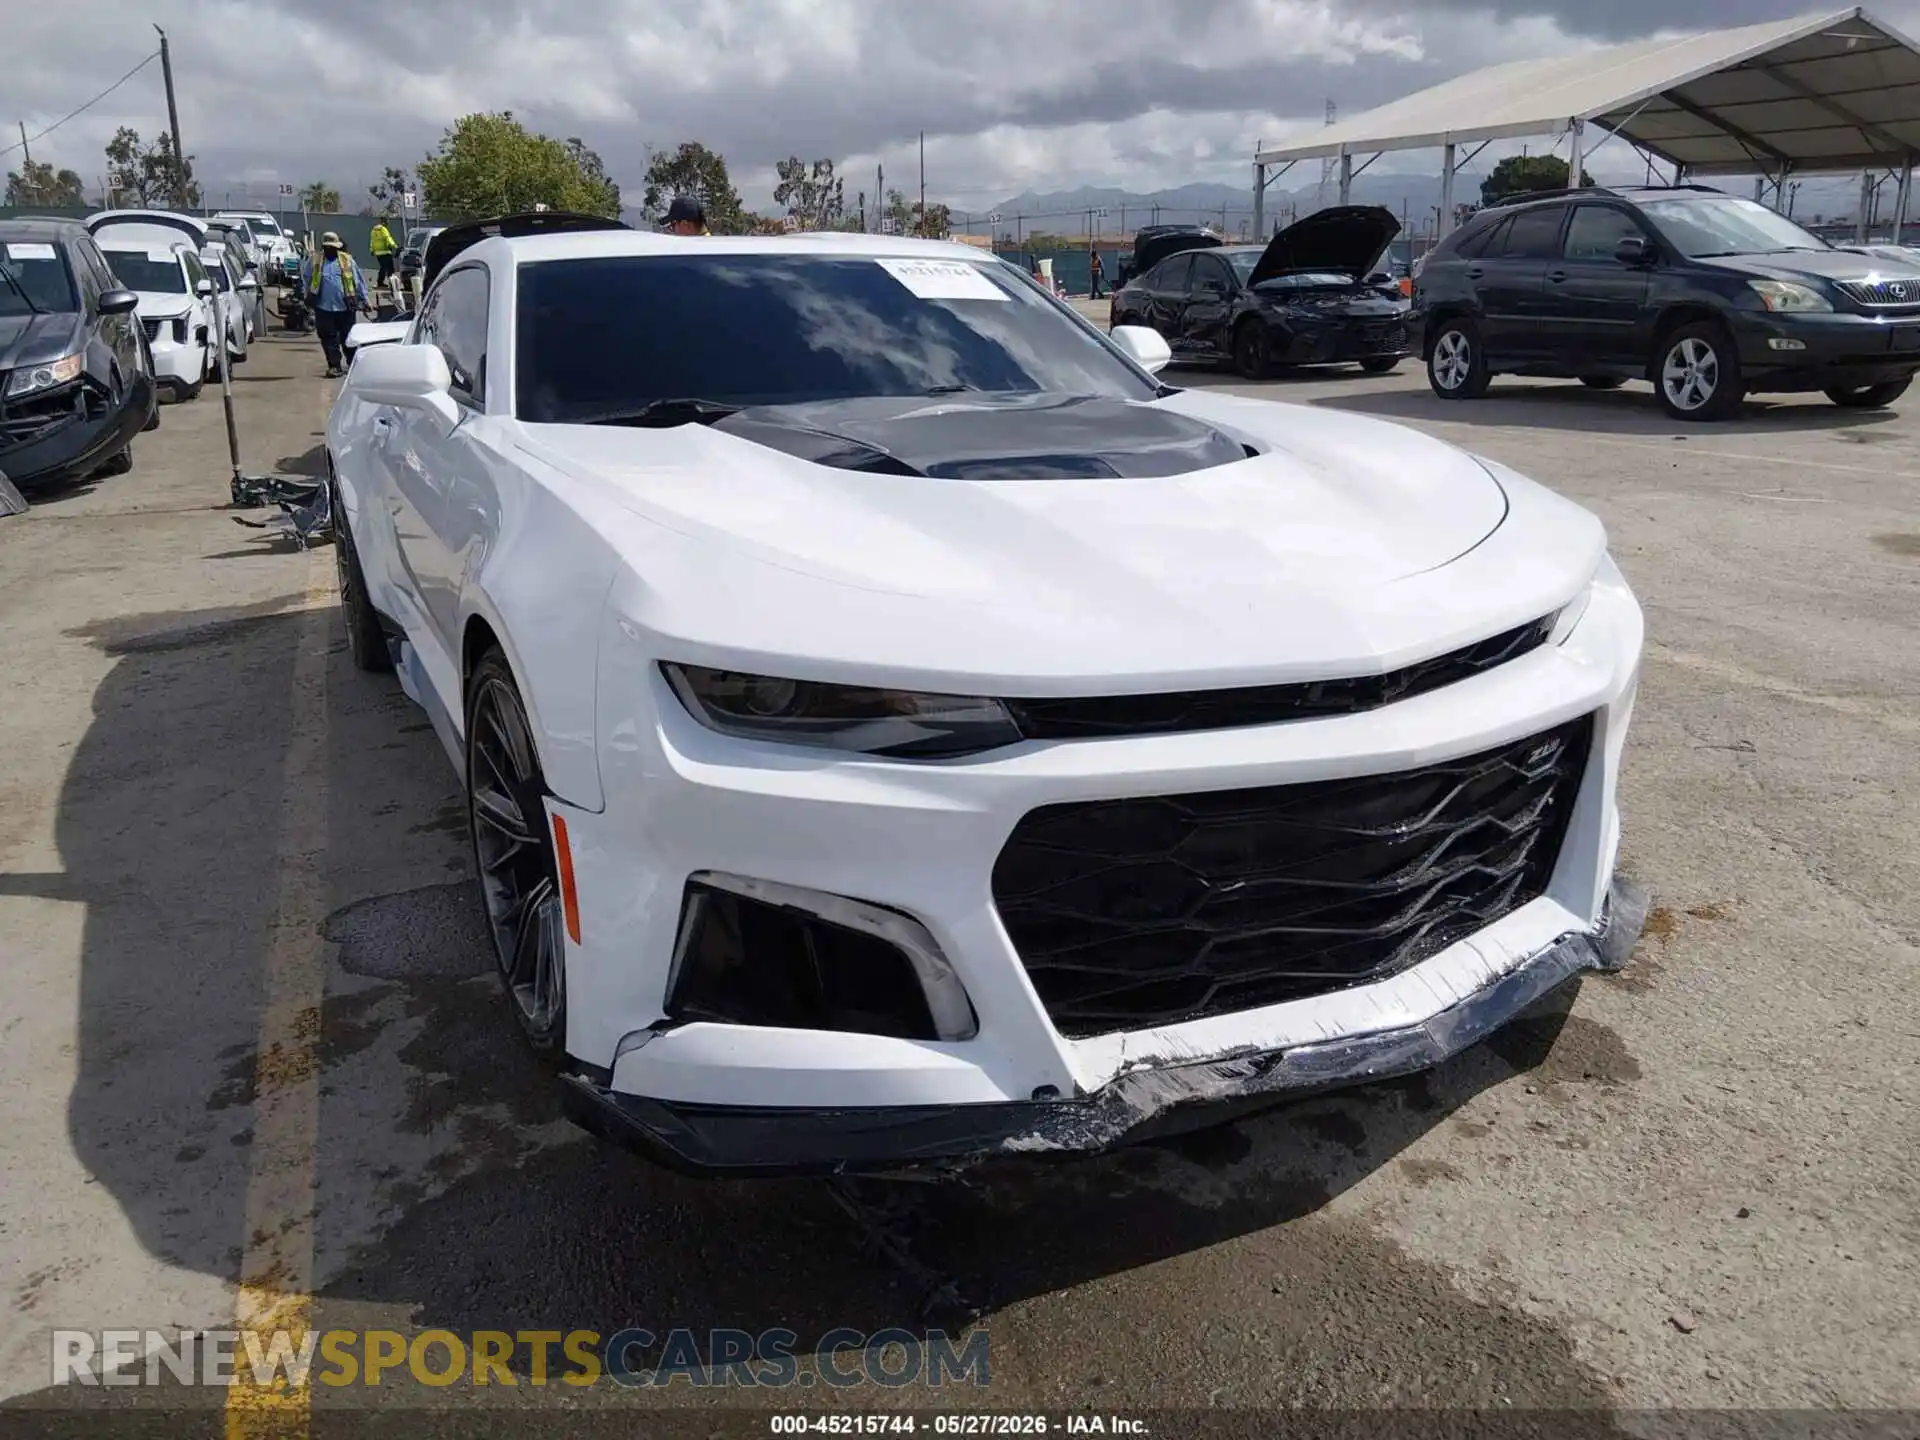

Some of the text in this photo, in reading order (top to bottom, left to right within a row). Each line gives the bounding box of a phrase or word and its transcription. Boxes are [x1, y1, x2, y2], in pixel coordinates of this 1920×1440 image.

[107, 176, 122, 187] 19
[279, 184, 293, 195] 18
[405, 195, 417, 206] 17
